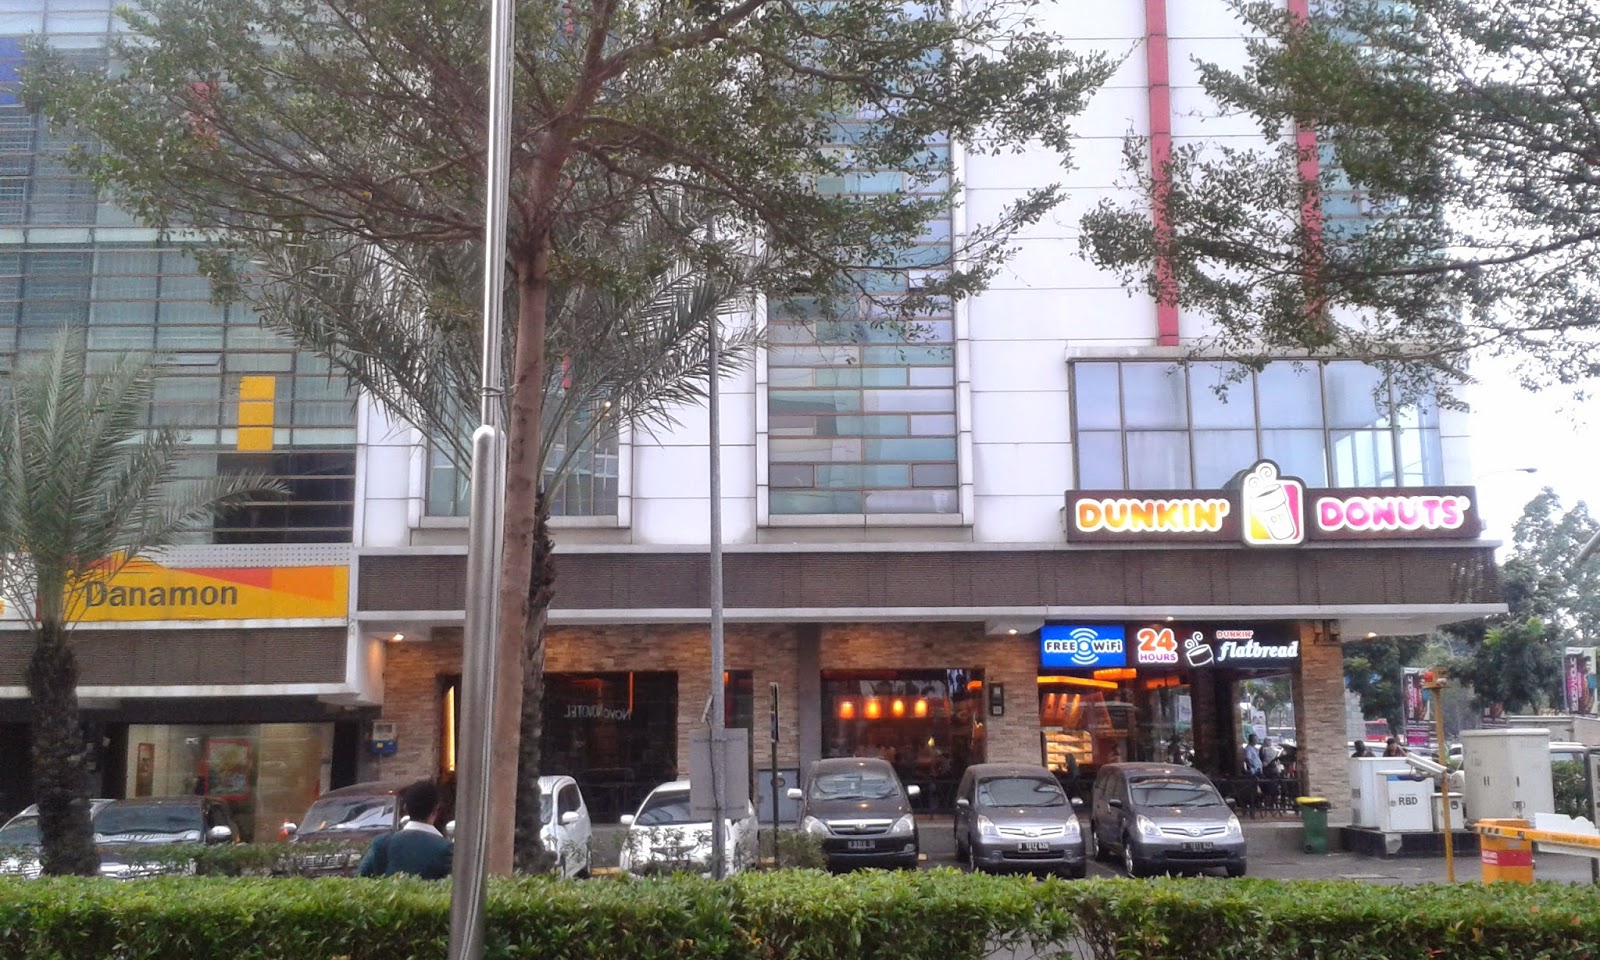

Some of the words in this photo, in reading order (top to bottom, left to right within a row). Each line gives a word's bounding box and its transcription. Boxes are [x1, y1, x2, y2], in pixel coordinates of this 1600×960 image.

[1077, 500, 1228, 530] DUNKIN'
[85, 581, 238, 607] Danamon
[1046, 641, 1076, 651] FREE
[1093, 641, 1121, 651] WiFi
[1139, 629, 1175, 652] 24
[1218, 639, 1298, 661] flatbread
[1140, 653, 1177, 661] HOURS
[1398, 796, 1418, 805] RBD
